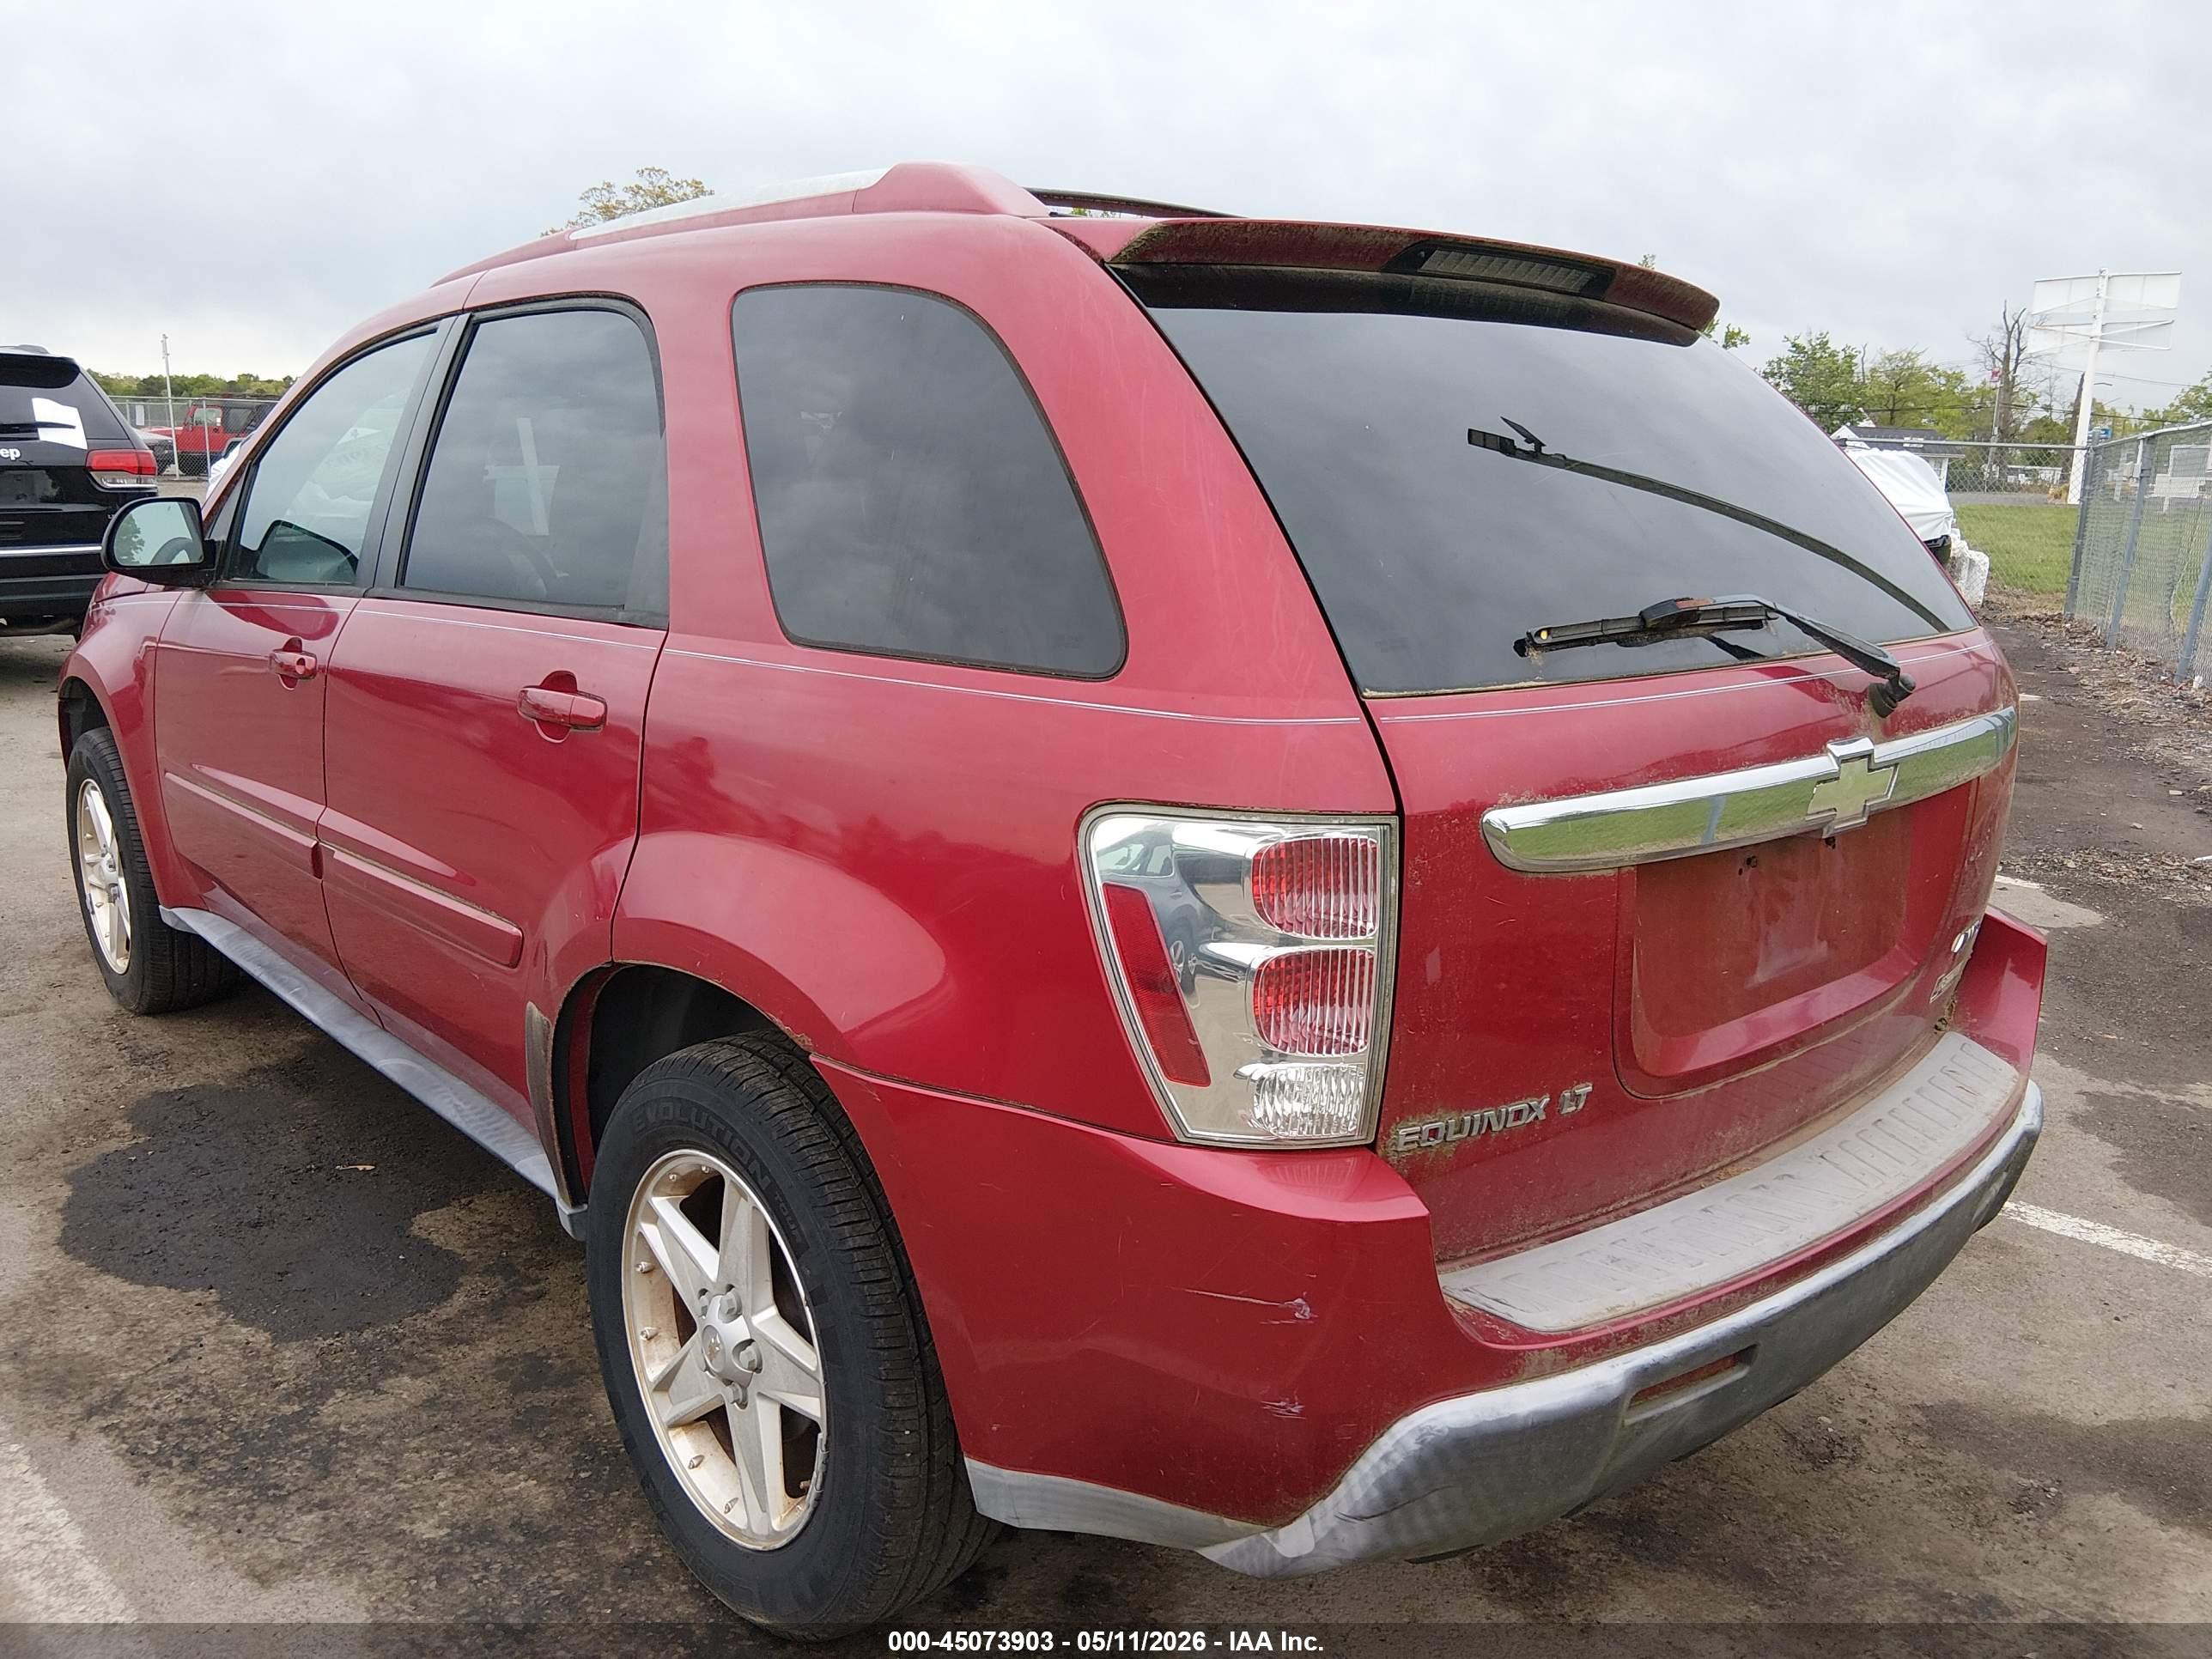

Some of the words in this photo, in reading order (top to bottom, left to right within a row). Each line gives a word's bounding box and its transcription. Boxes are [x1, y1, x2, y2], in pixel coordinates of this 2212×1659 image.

[0, 447, 21, 461] ep
[631, 1101, 772, 1191] EVOLUTION
[1396, 1097, 1551, 1152] EQUINOX
[1559, 1084, 1594, 1115] LT
